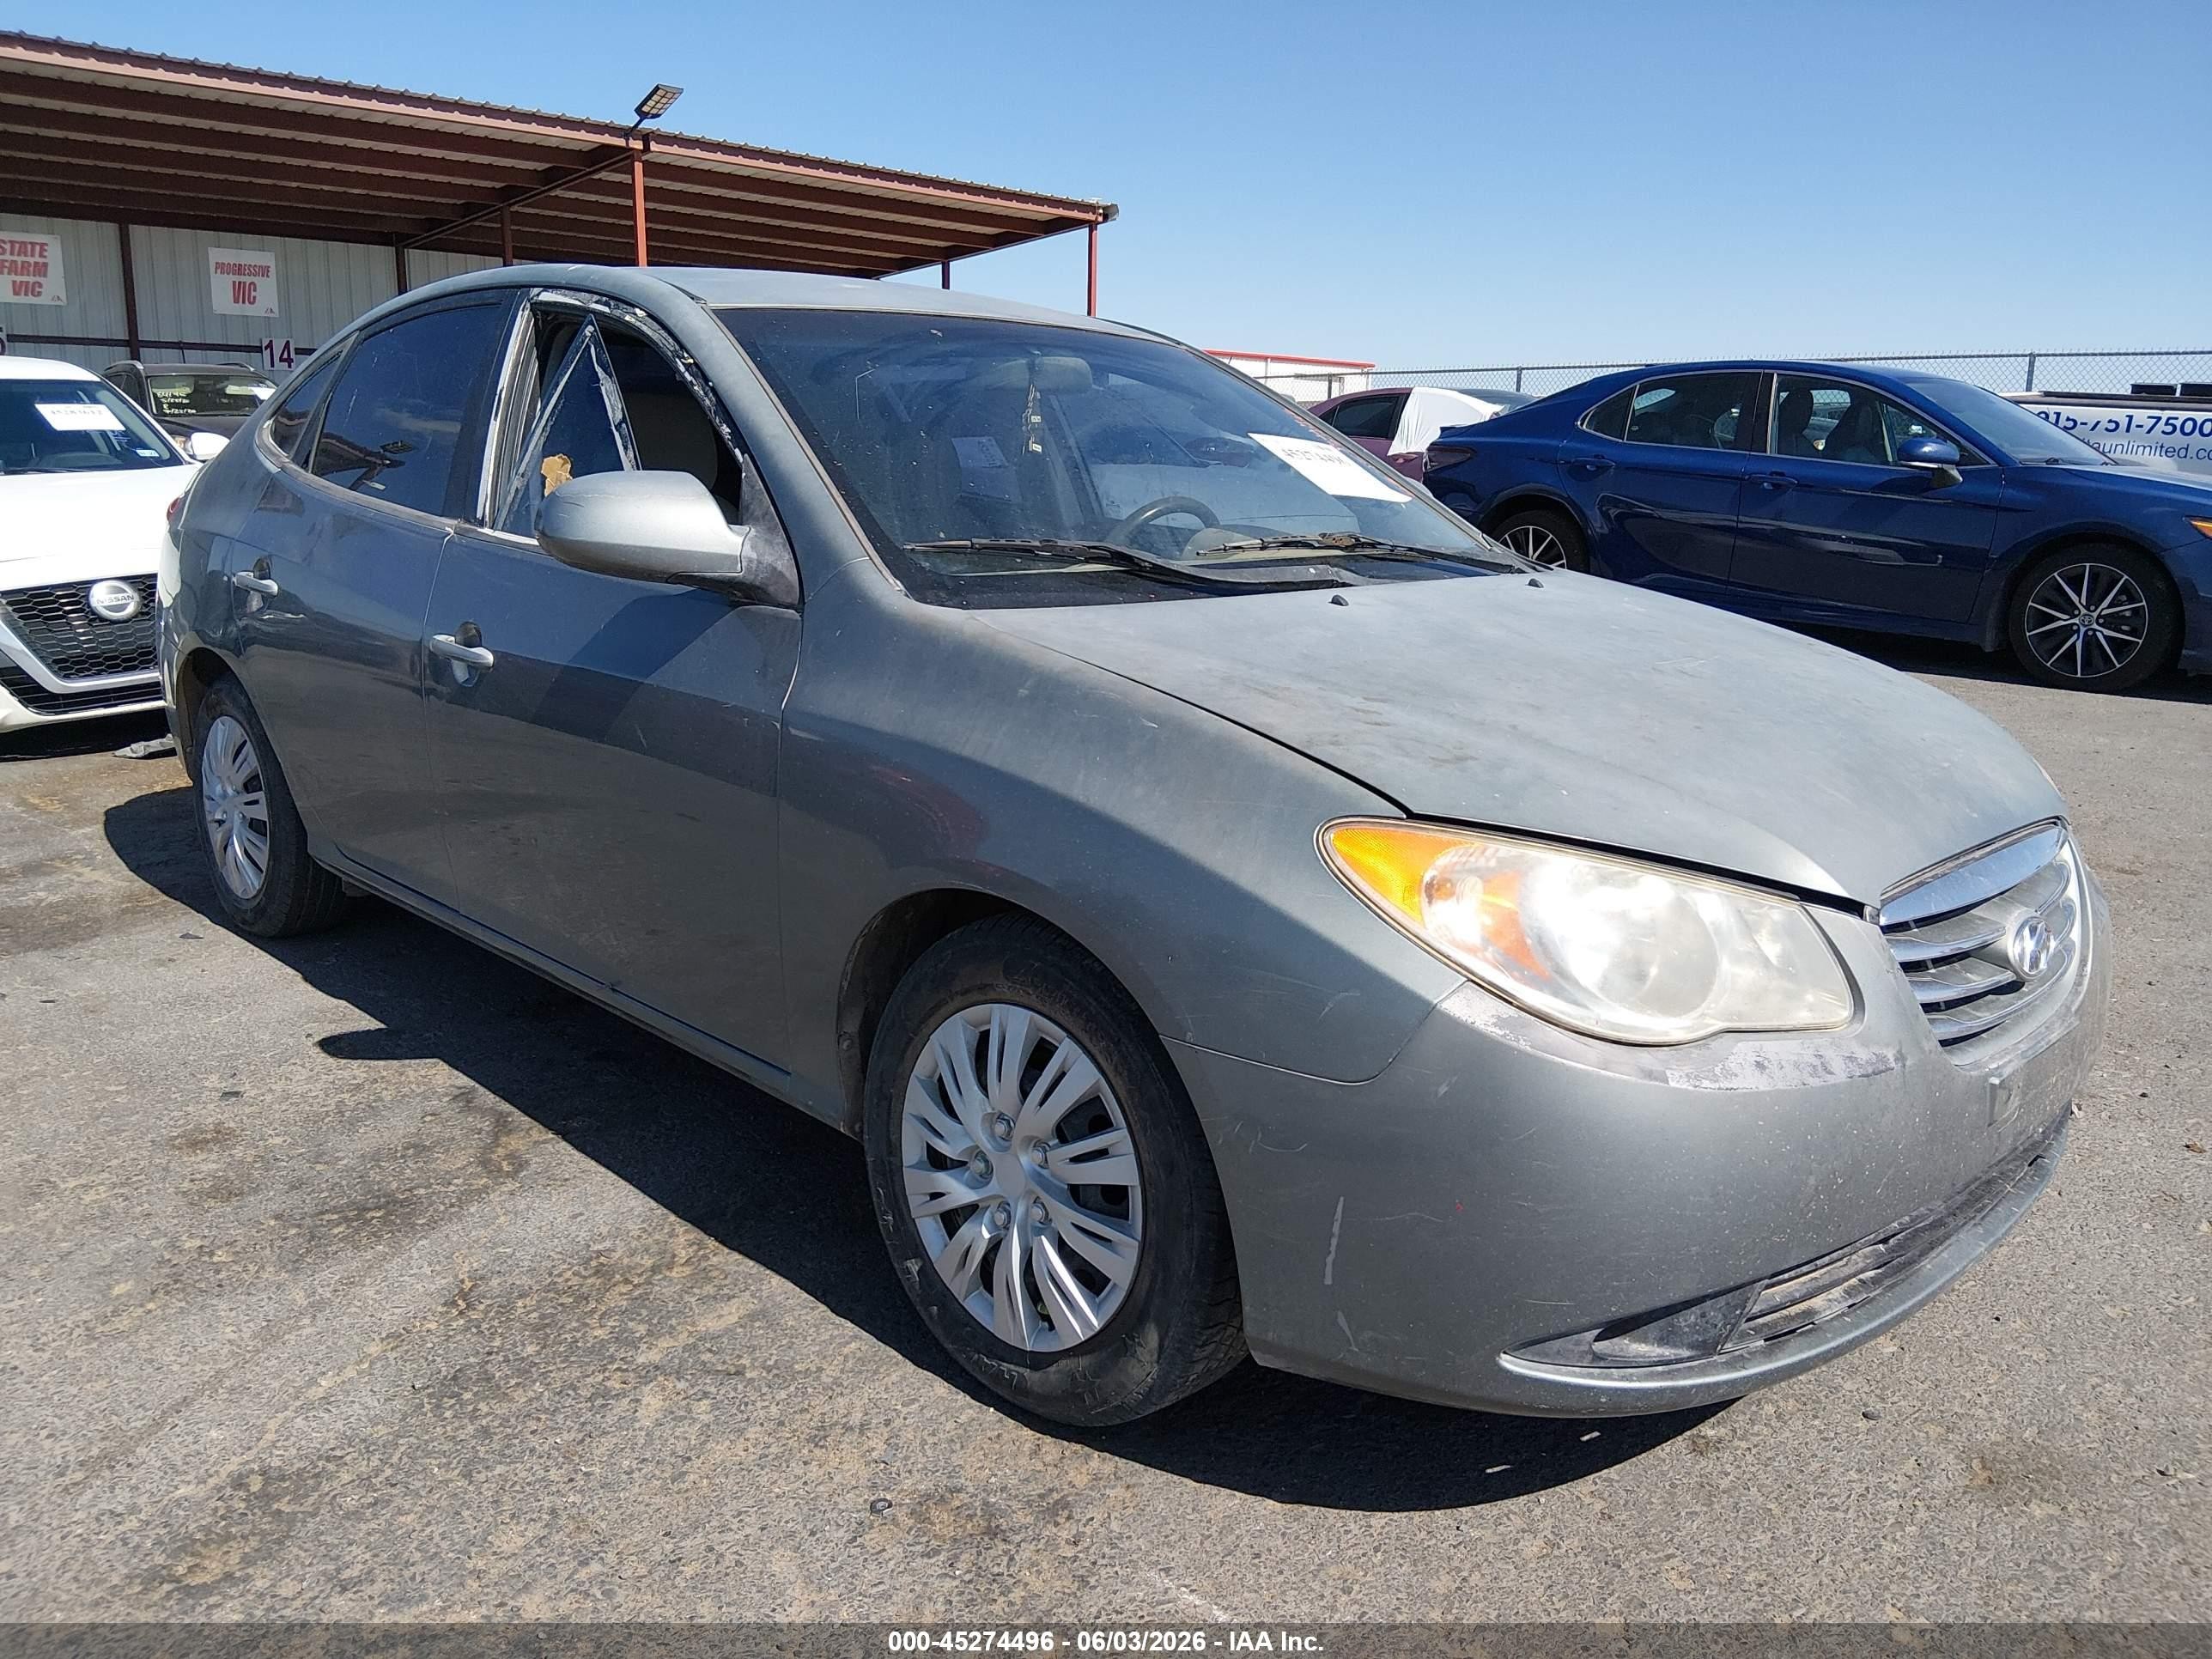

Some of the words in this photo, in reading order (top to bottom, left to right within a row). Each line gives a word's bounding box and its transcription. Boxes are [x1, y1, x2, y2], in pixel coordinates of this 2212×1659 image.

[0, 239, 48, 258] STATE
[0, 259, 49, 277] FARM
[215, 261, 271, 278] PROGRESSIVE
[11, 280, 43, 297] VIC
[232, 280, 257, 305] VIC
[264, 339, 294, 369] 14
[96, 594, 135, 605] NISSAN
